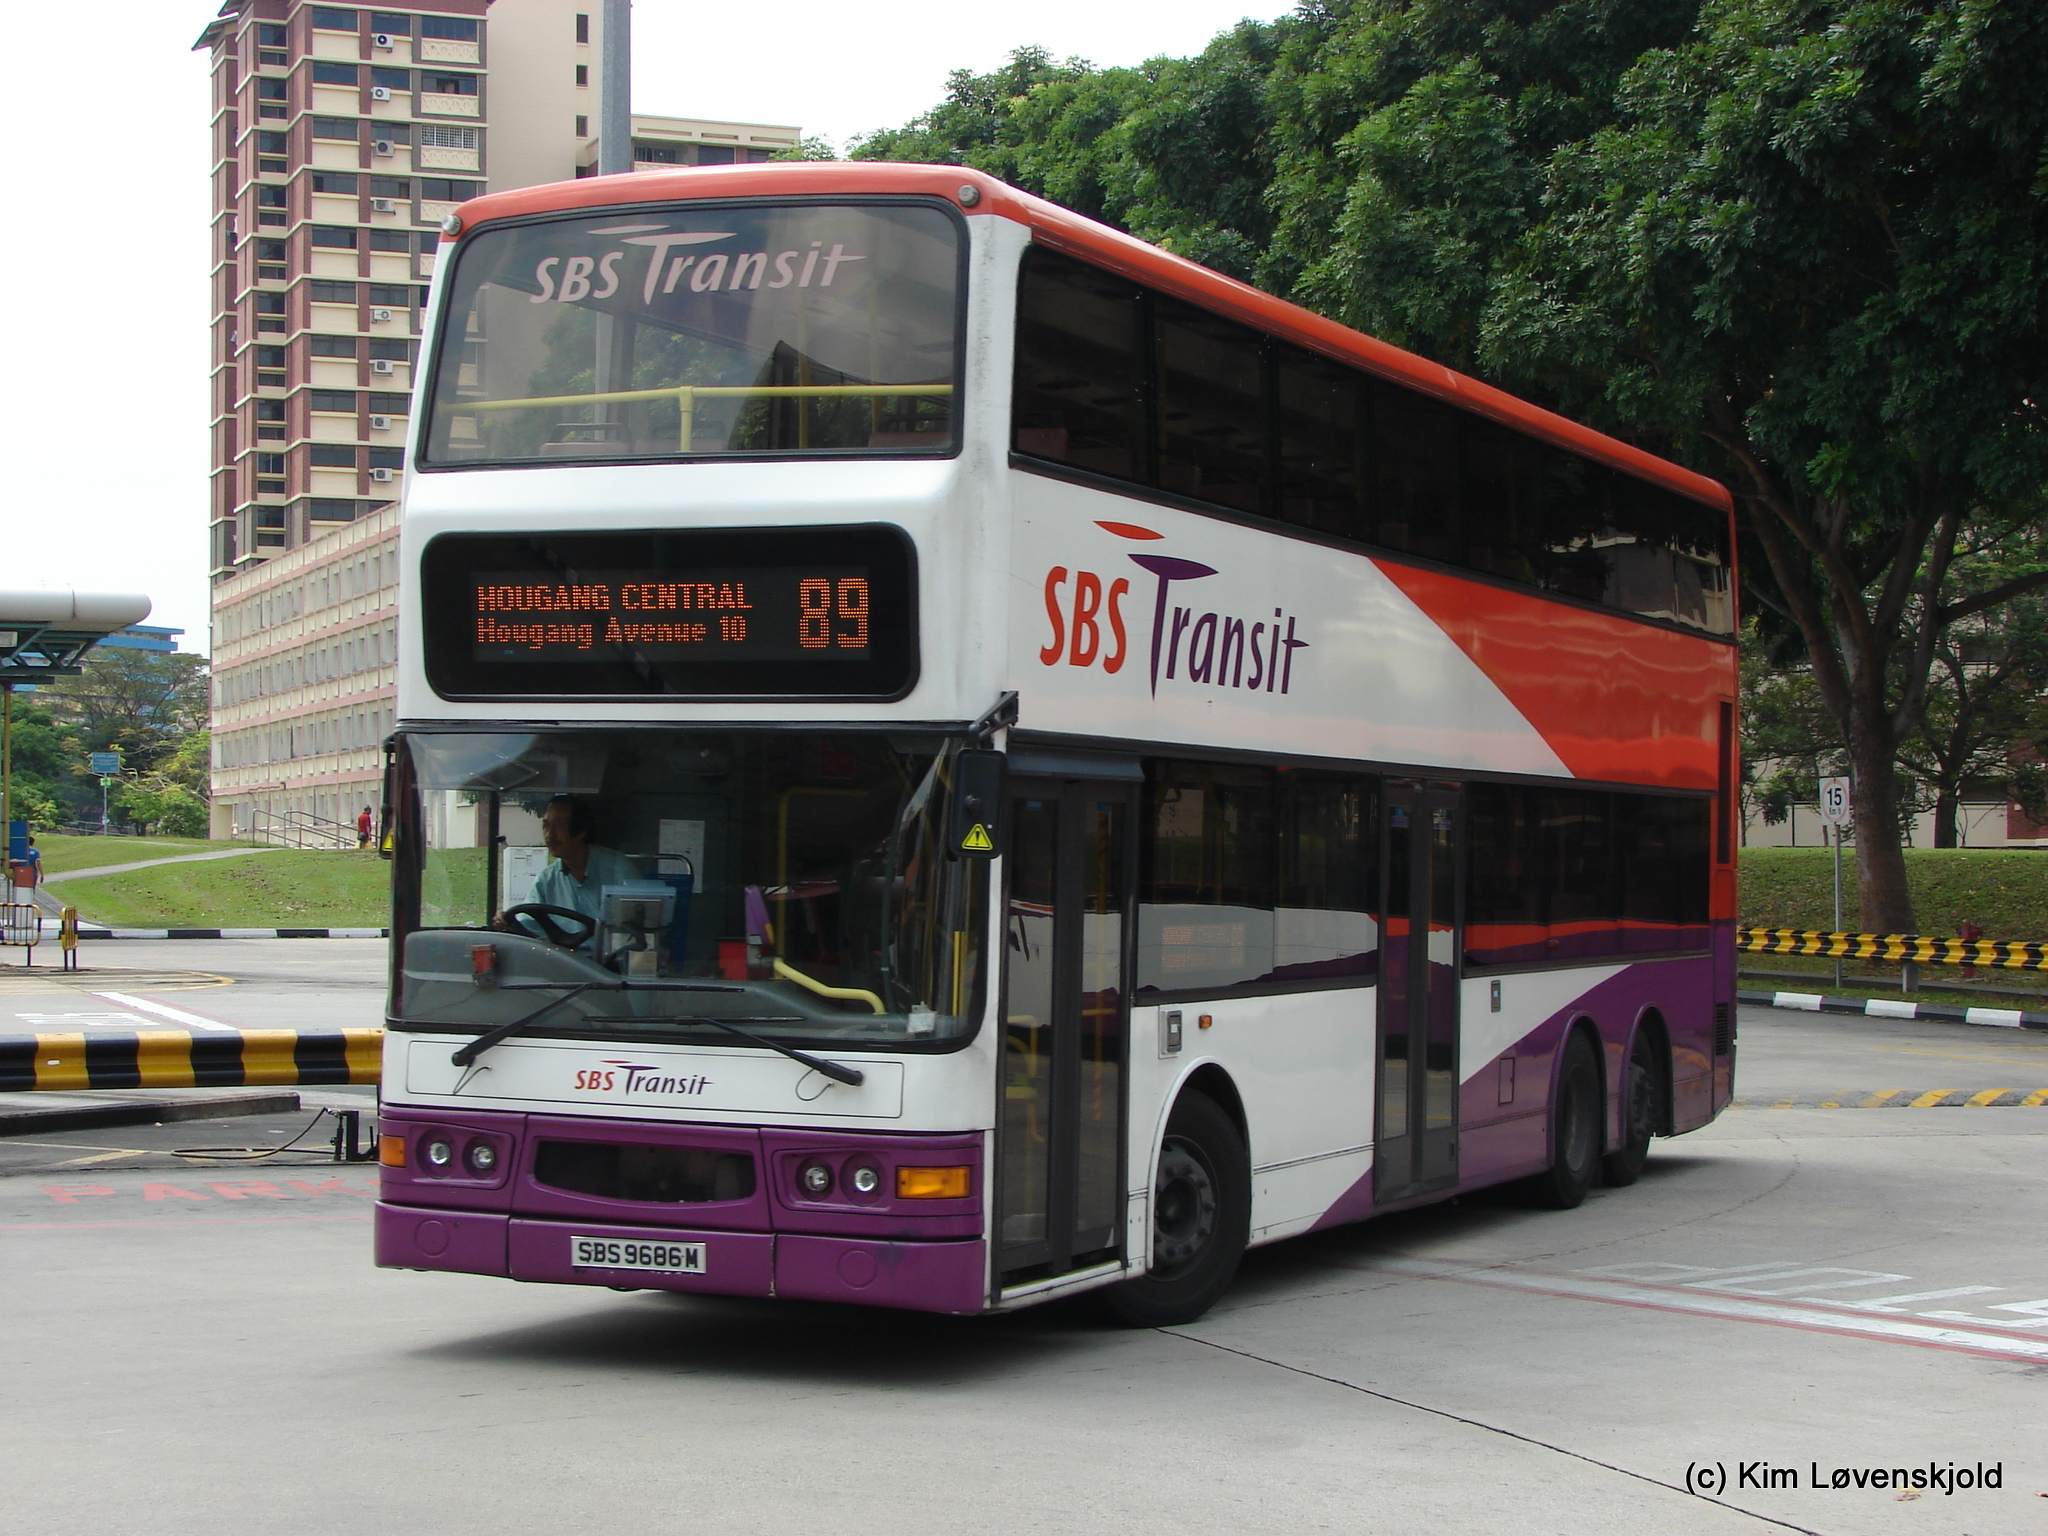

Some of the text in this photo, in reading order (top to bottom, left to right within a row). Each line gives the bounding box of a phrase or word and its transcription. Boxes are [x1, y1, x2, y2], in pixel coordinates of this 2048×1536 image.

[530, 232, 868, 305] SBS Transit
[477, 583, 753, 611] HOUGANG CENTRAL
[799, 577, 870, 648] 89
[1040, 553, 1310, 702] SBS Transit
[477, 615, 748, 650] Hougang Avenue 10
[1827, 787, 1842, 806] 15
[574, 1065, 715, 1095] SBS Transit
[38, 1178, 381, 1203] PARK
[578, 1241, 699, 1269] SBS9686M
